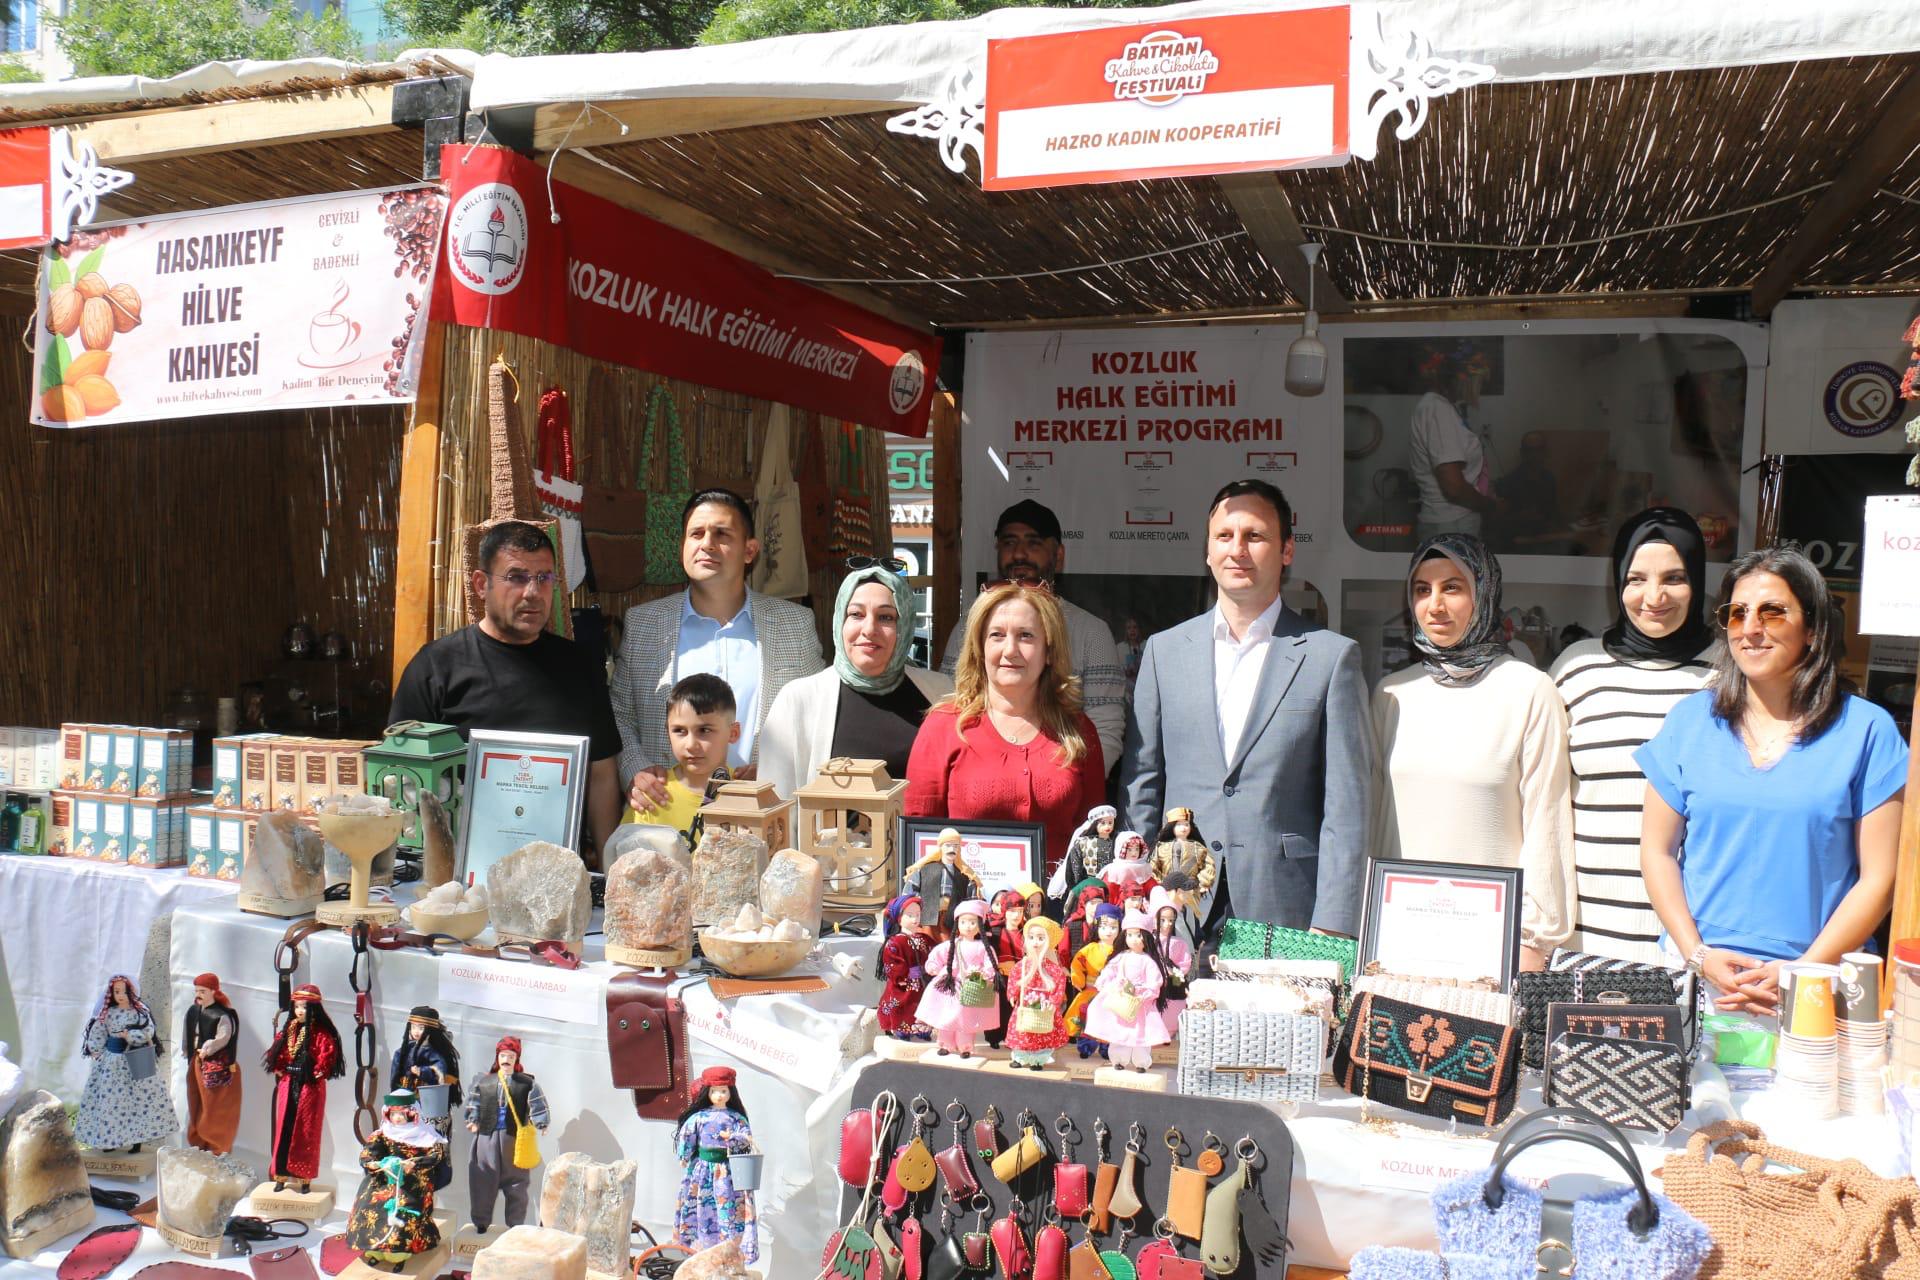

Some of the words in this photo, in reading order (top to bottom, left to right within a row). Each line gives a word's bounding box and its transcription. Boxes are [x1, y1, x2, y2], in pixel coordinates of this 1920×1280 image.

[1127, 41, 1199, 61] BATMAN
[1108, 61, 1151, 79] Kahve
[1152, 64, 1160, 74] &
[1160, 55, 1215, 75] Çikolata
[1045, 133, 1103, 151] HAZRO
[1106, 129, 1161, 148] KADIN
[1165, 117, 1281, 143] KOOPERATİFİ
[318, 208, 360, 228] CEVİZLİ
[156, 226, 284, 275] HASANKEYF
[332, 233, 344, 247] &
[313, 251, 360, 271] BADEMLİ
[182, 283, 243, 326] HİLVE
[569, 257, 657, 320] KOZLUK
[659, 291, 718, 338] HALK
[718, 308, 796, 360] EĞİTİMİ
[788, 338, 862, 381] MERKEZİ
[168, 332, 260, 383] KAHVESİ
[1091, 350, 1198, 375] KOZLUK
[318, 376, 335, 387] Bir
[338, 374, 384, 388] Deneyim
[156, 387, 262, 404] www.hilvekahvesi.com
[1056, 386, 1126, 411] HALK
[1135, 380, 1237, 408] EĞİTİMİ
[1014, 415, 1128, 444] MERKEZİ
[1137, 418, 1283, 444] PROGRAMI
[451, 967, 482, 981] KOZLUK
[528, 980, 568, 993] LAMBASI
[1380, 1159, 1435, 1176] KOZLUK
